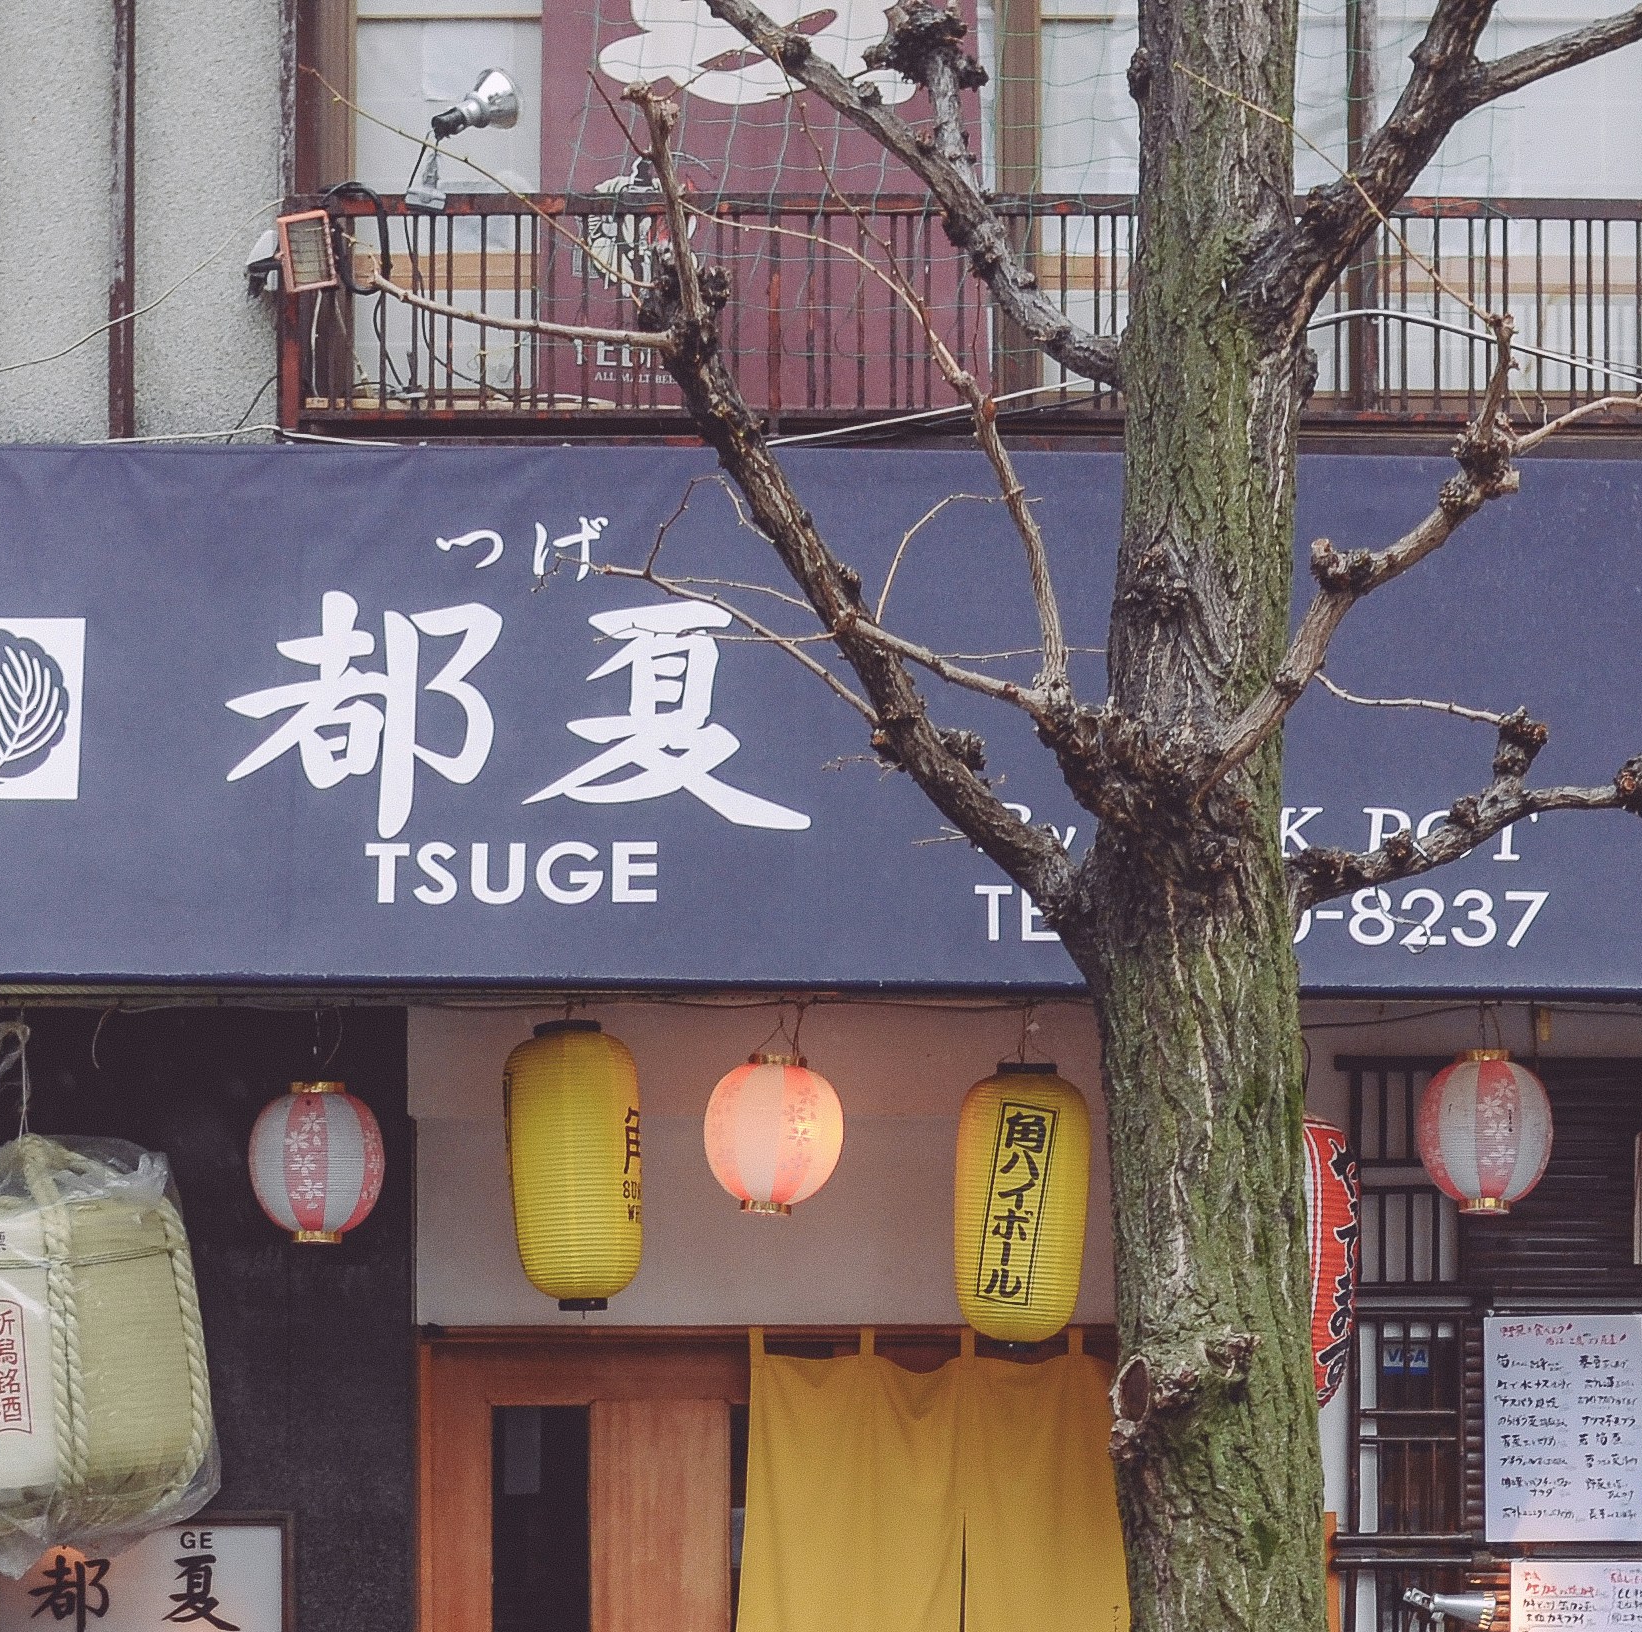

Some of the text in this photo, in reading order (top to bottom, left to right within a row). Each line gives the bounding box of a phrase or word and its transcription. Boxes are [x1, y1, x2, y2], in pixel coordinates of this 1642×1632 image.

[436, 515, 609, 582] つげ
[224, 590, 812, 839] 都夏
[364, 841, 659, 905] TSUGE
[983, 1111, 1047, 1299] 角ハイボール
